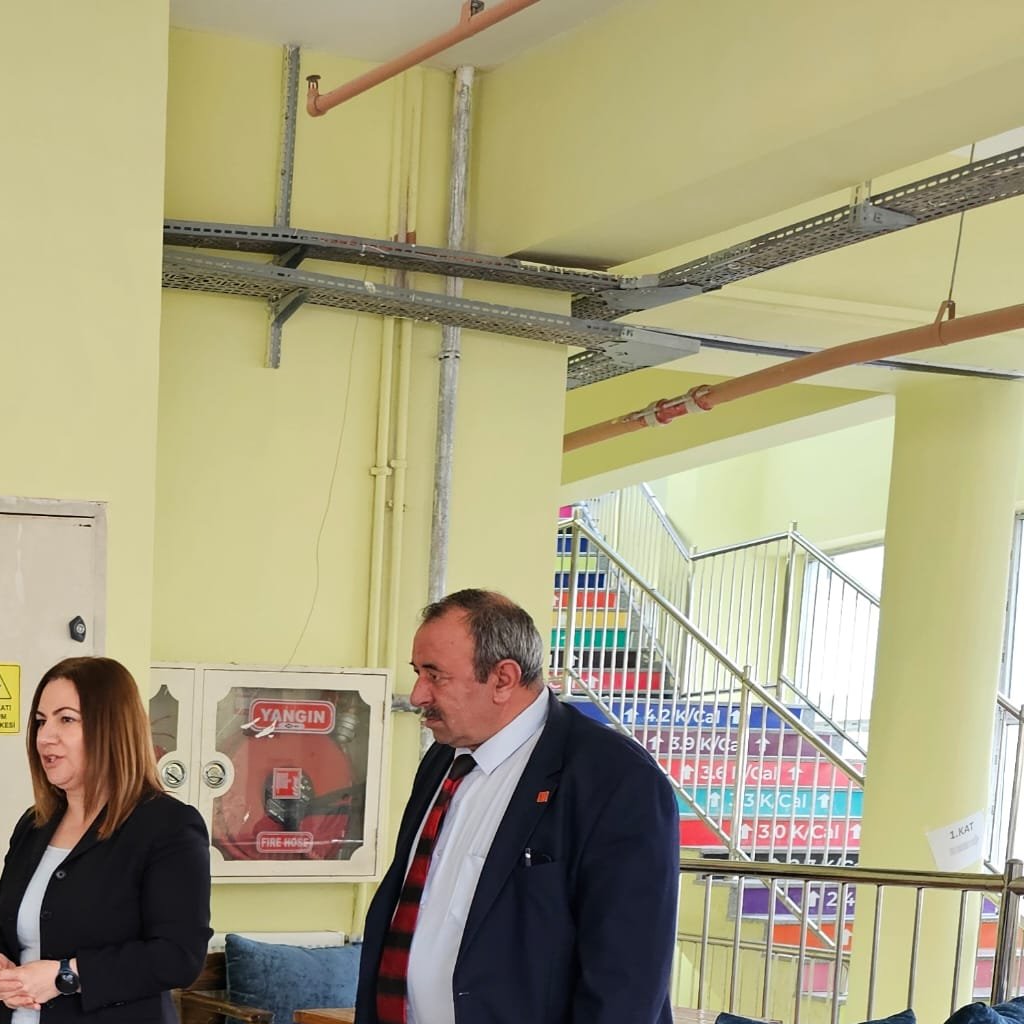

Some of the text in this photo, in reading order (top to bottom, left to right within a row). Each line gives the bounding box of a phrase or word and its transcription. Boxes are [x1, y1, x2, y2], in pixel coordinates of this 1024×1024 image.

[260, 707, 326, 723] YANGIN
[646, 707, 721, 724] 4.2 K/Cal
[671, 735, 739, 752] 3.9 K/Ca
[699, 765, 724, 780] 3.6
[758, 824, 786, 839] 30
[261, 837, 282, 848] FIRE
[826, 891, 856, 907] 24
